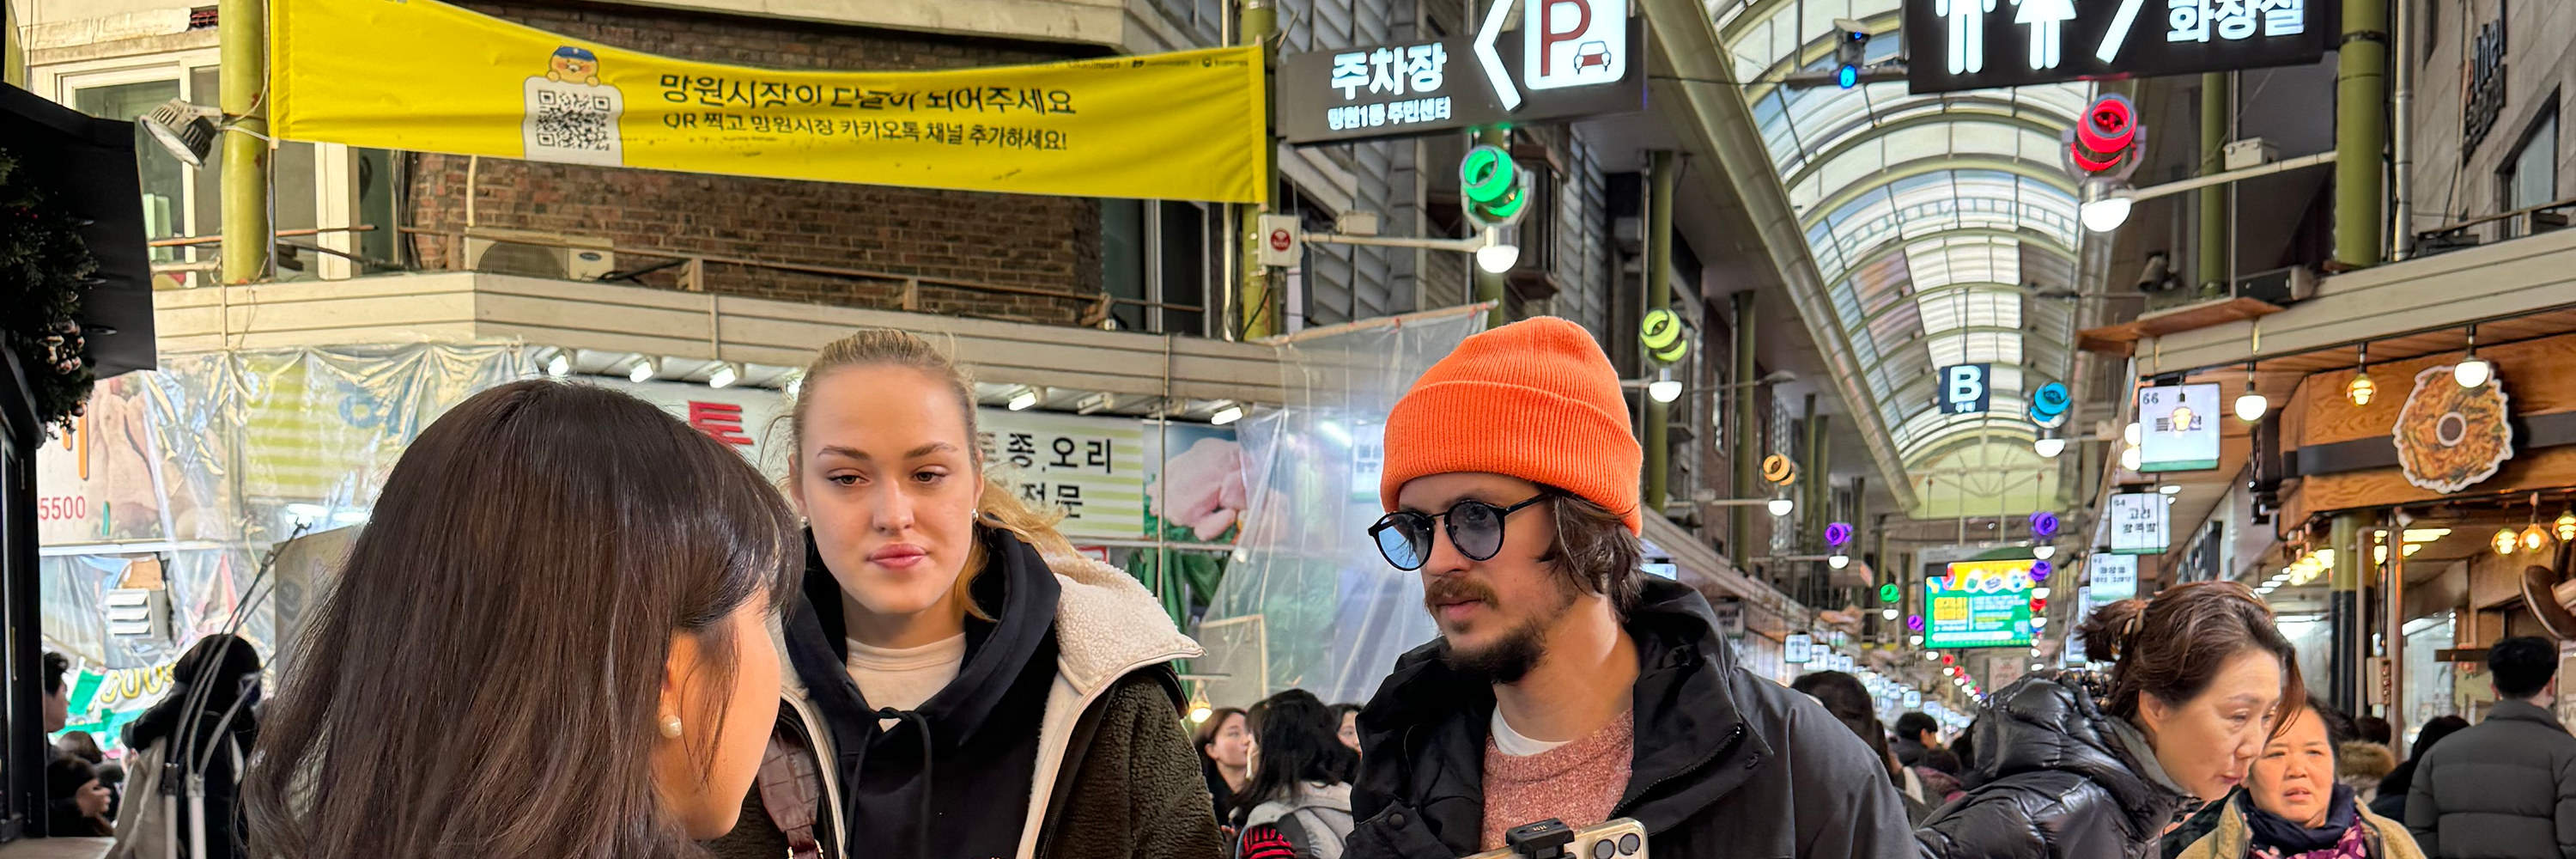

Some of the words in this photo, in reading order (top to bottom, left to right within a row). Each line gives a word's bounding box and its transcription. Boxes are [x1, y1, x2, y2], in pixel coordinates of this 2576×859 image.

[1541, 0, 1591, 77] P
[2167, 0, 2304, 42] 화장실
[1331, 42, 1448, 100] 주차장
[659, 74, 822, 108] 망원시장이
[1387, 96, 1451, 125] 주민센터
[663, 113, 697, 129] QR
[703, 113, 747, 131] 찍고
[750, 113, 834, 135] 망원시장
[840, 119, 920, 142] 카카오톡
[925, 122, 964, 145] 채널
[969, 125, 1067, 150] 추가하세요!
[1949, 365, 1983, 404] B
[2142, 393, 2160, 405] 66
